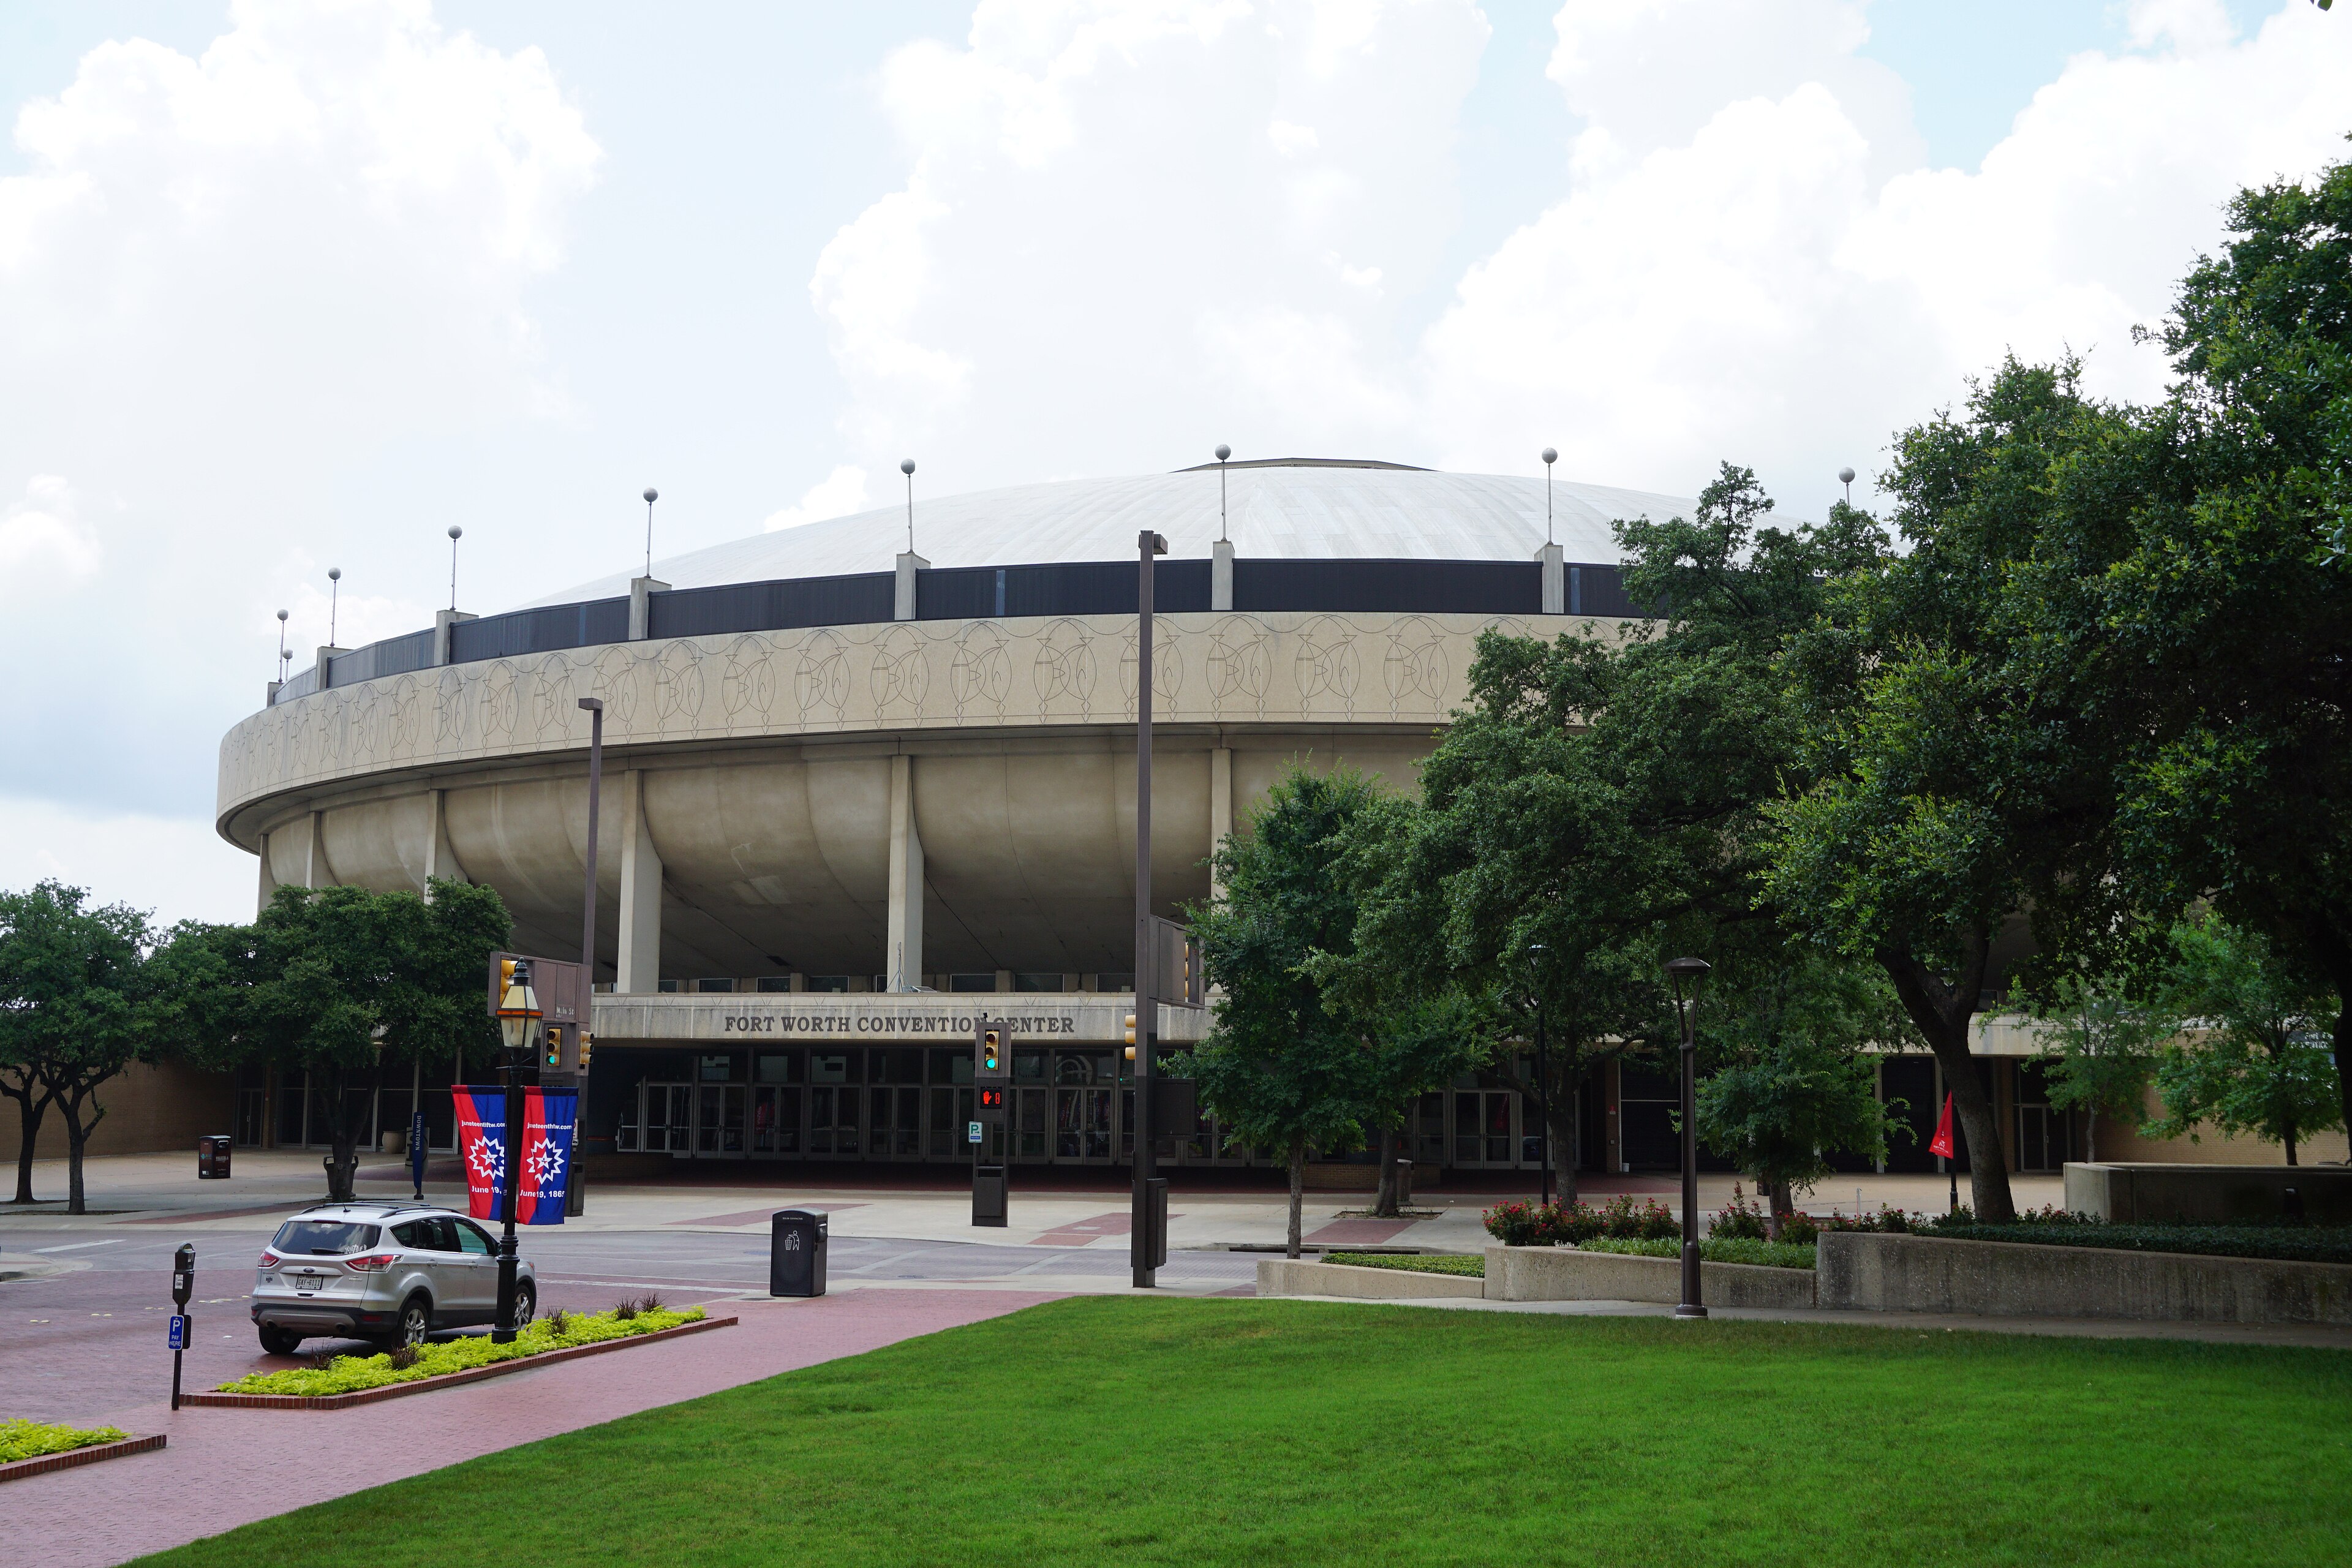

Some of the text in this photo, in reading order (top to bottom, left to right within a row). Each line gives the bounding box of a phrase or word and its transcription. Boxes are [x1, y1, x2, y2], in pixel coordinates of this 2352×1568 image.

[725, 1017, 775, 1032] FORT
[781, 1017, 851, 1031] WORTH
[971, 1125, 979, 1134] P
[519, 1189, 536, 1197] June
[173, 1319, 180, 1332] P
